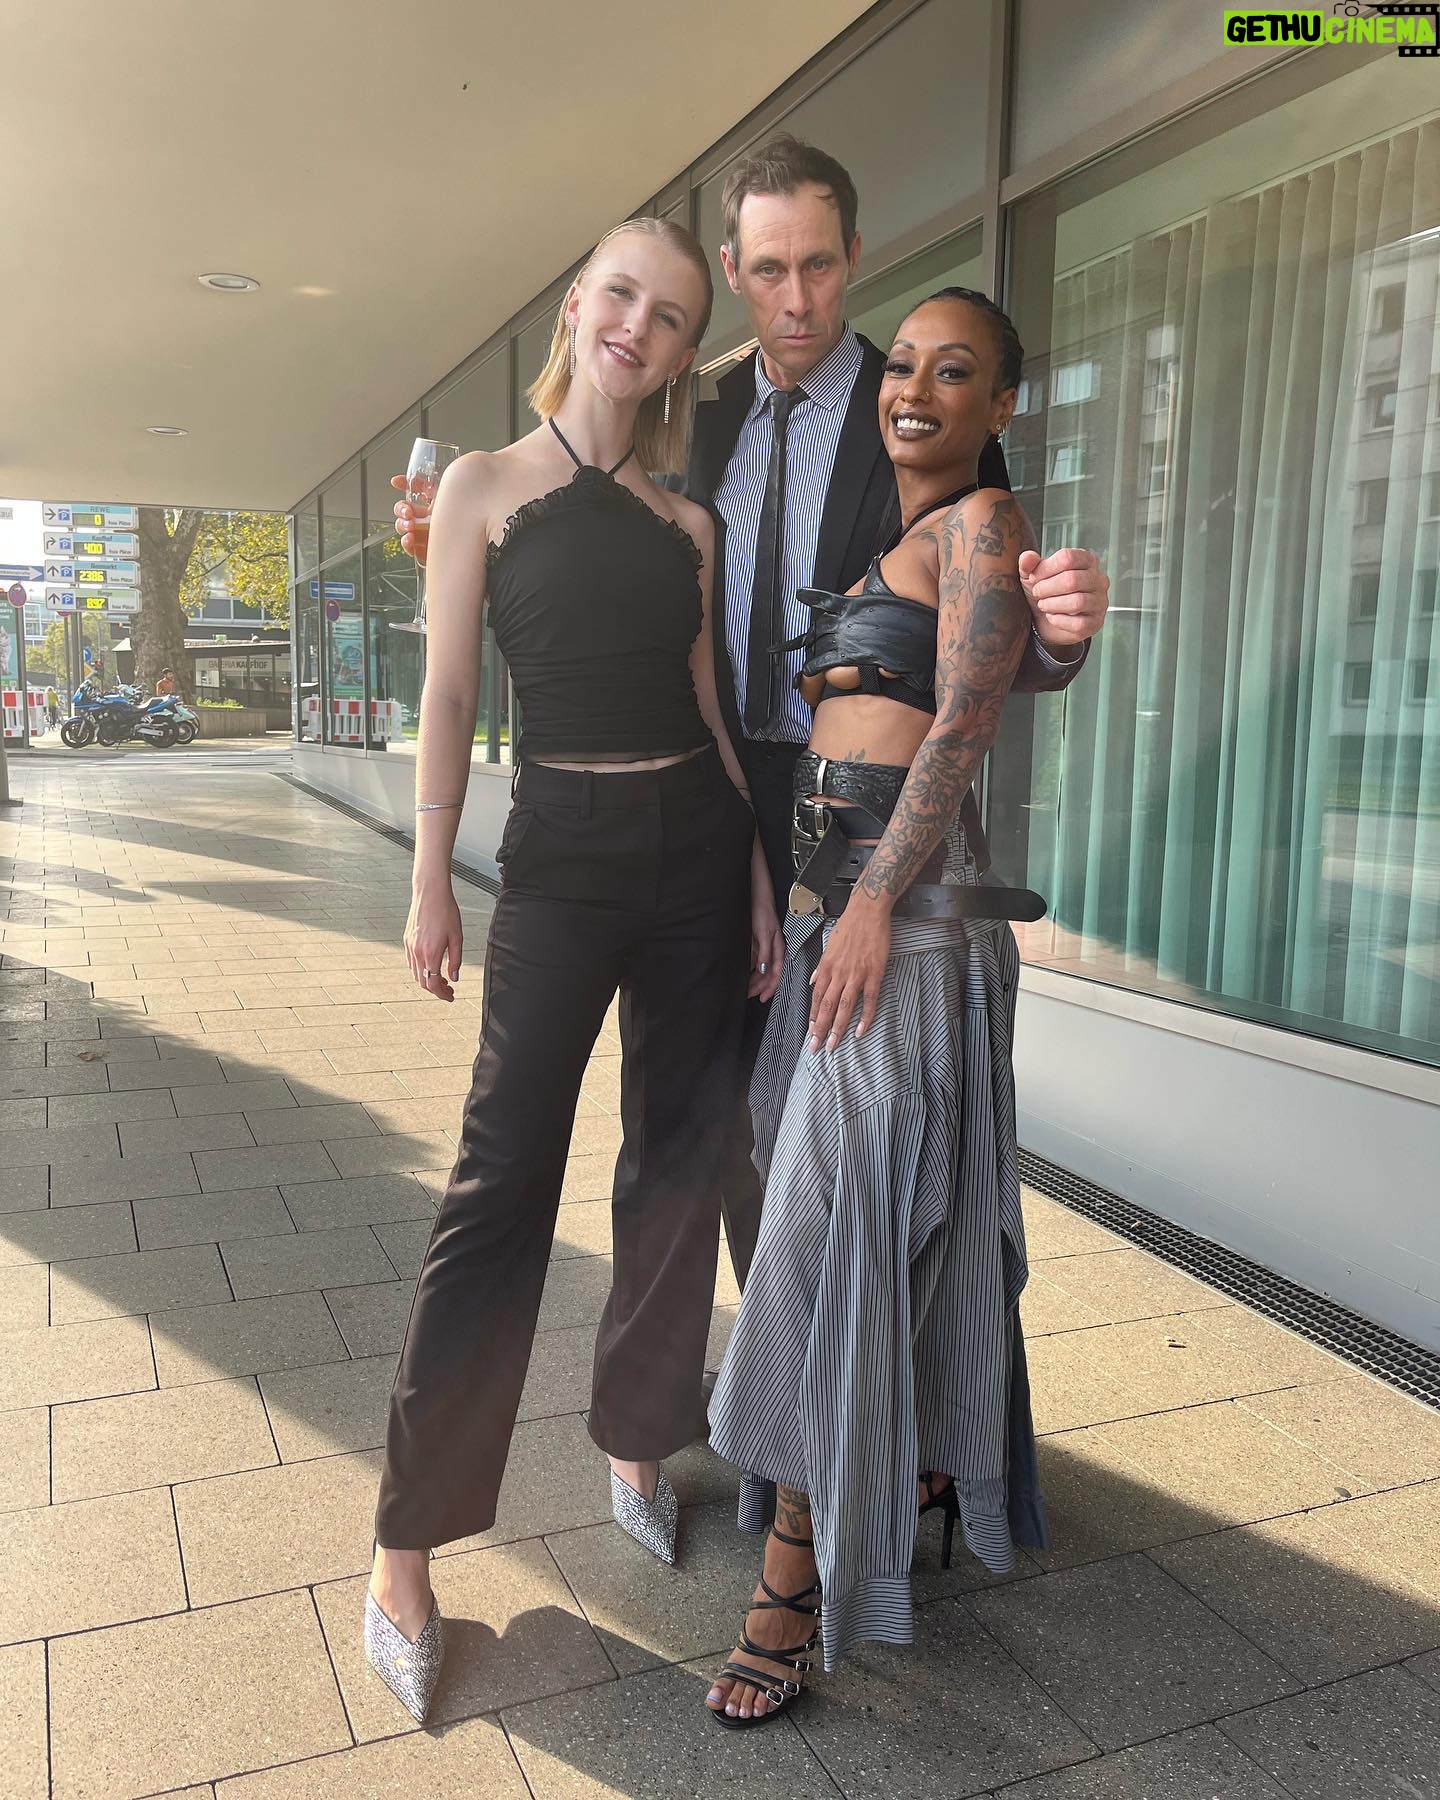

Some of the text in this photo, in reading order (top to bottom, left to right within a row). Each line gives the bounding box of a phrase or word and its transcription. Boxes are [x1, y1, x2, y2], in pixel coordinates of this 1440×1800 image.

[95, 514, 102, 525] 0
[84, 543, 103, 554] 400
[208, 660, 236, 669] GAERIA
